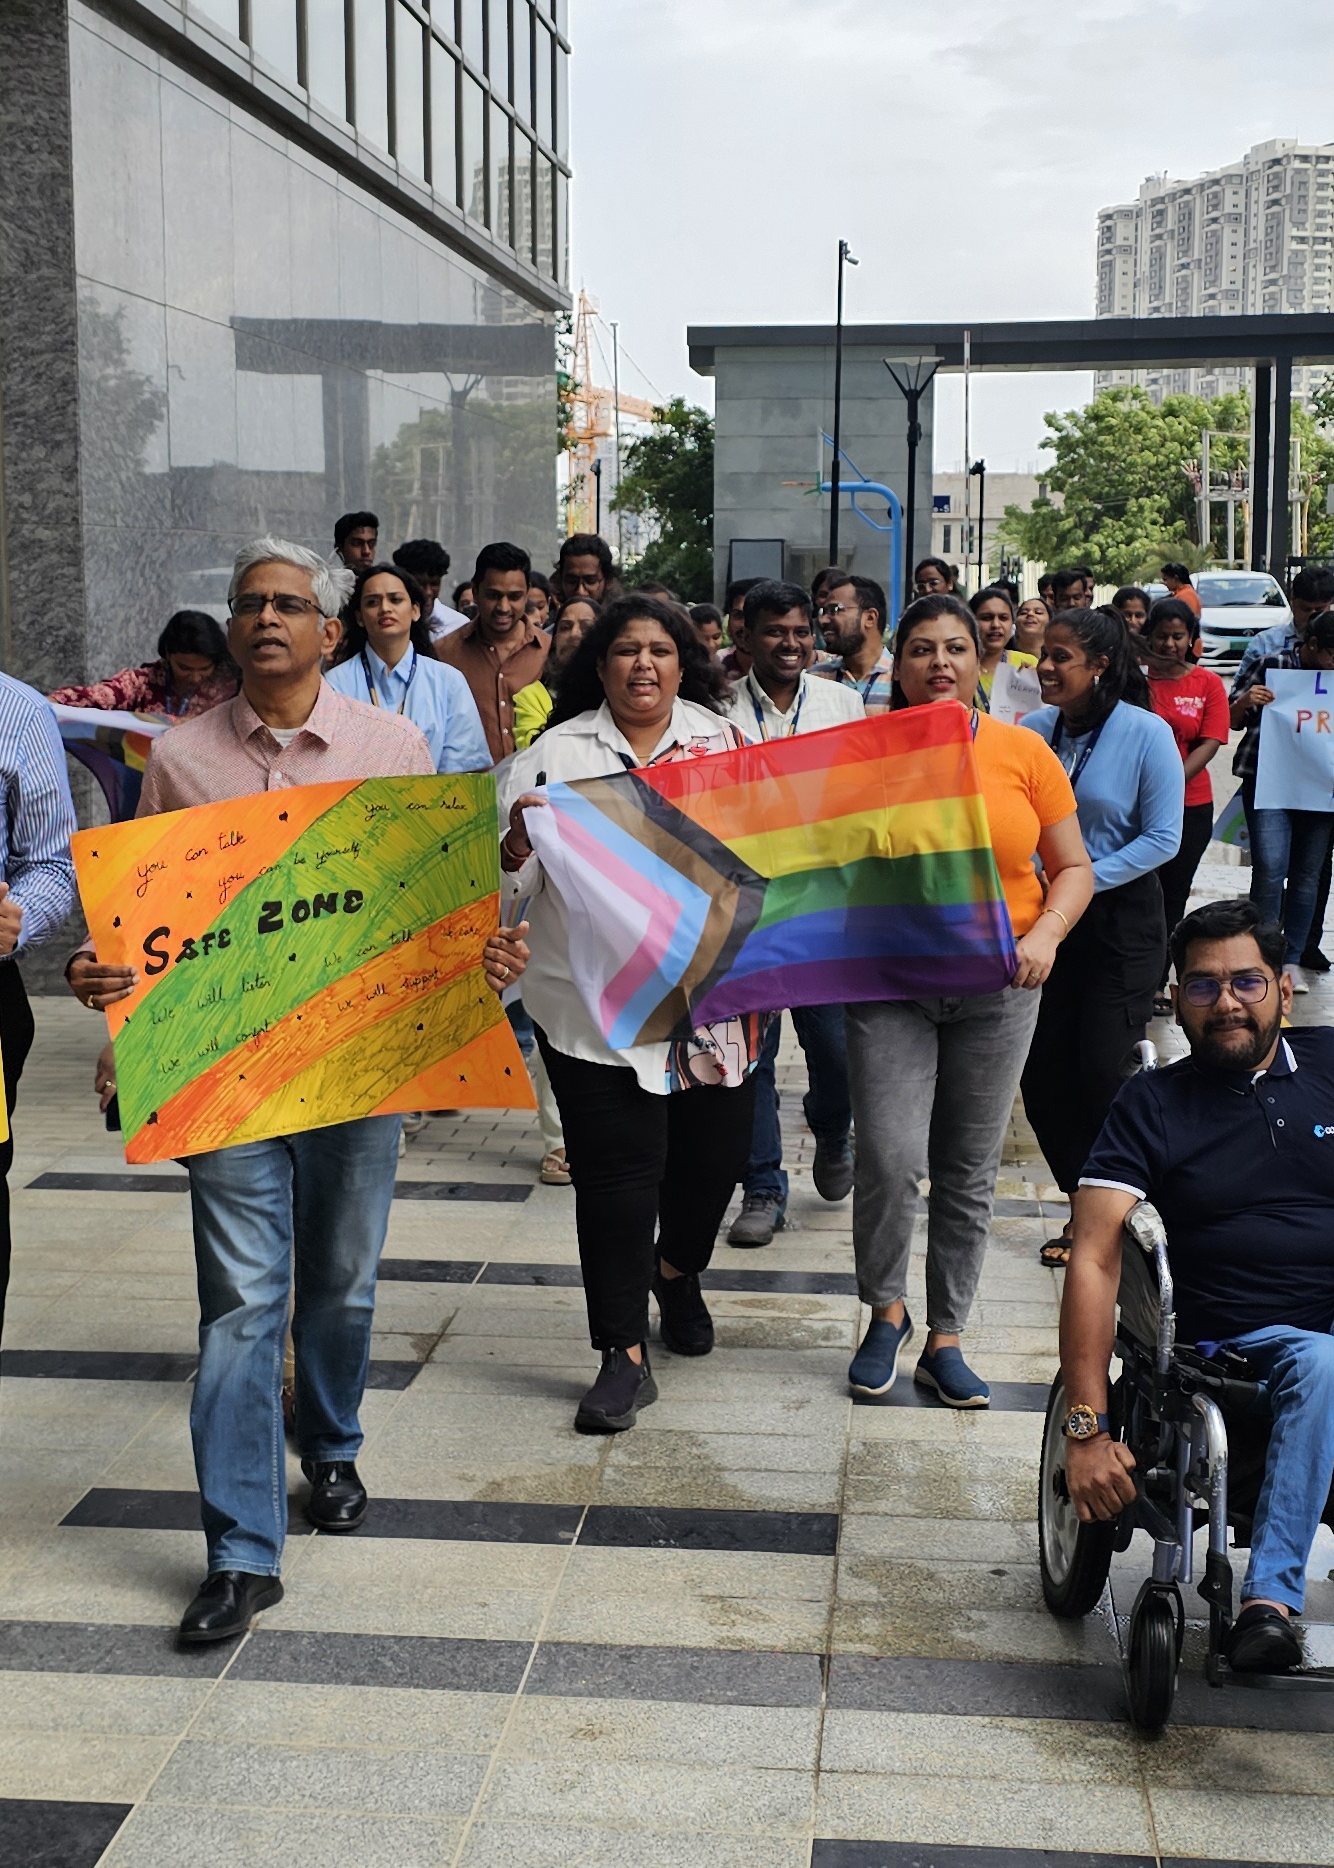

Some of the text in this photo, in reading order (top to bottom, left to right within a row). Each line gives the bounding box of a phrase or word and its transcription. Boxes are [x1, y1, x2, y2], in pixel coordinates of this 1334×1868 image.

[217, 830, 247, 851] talk
[315, 841, 362, 869] yourself
[257, 889, 365, 935] ZONE
[389, 929, 415, 945] talk
[400, 967, 441, 991] support
[196, 987, 226, 1009] will
[198, 1037, 219, 1058] will
